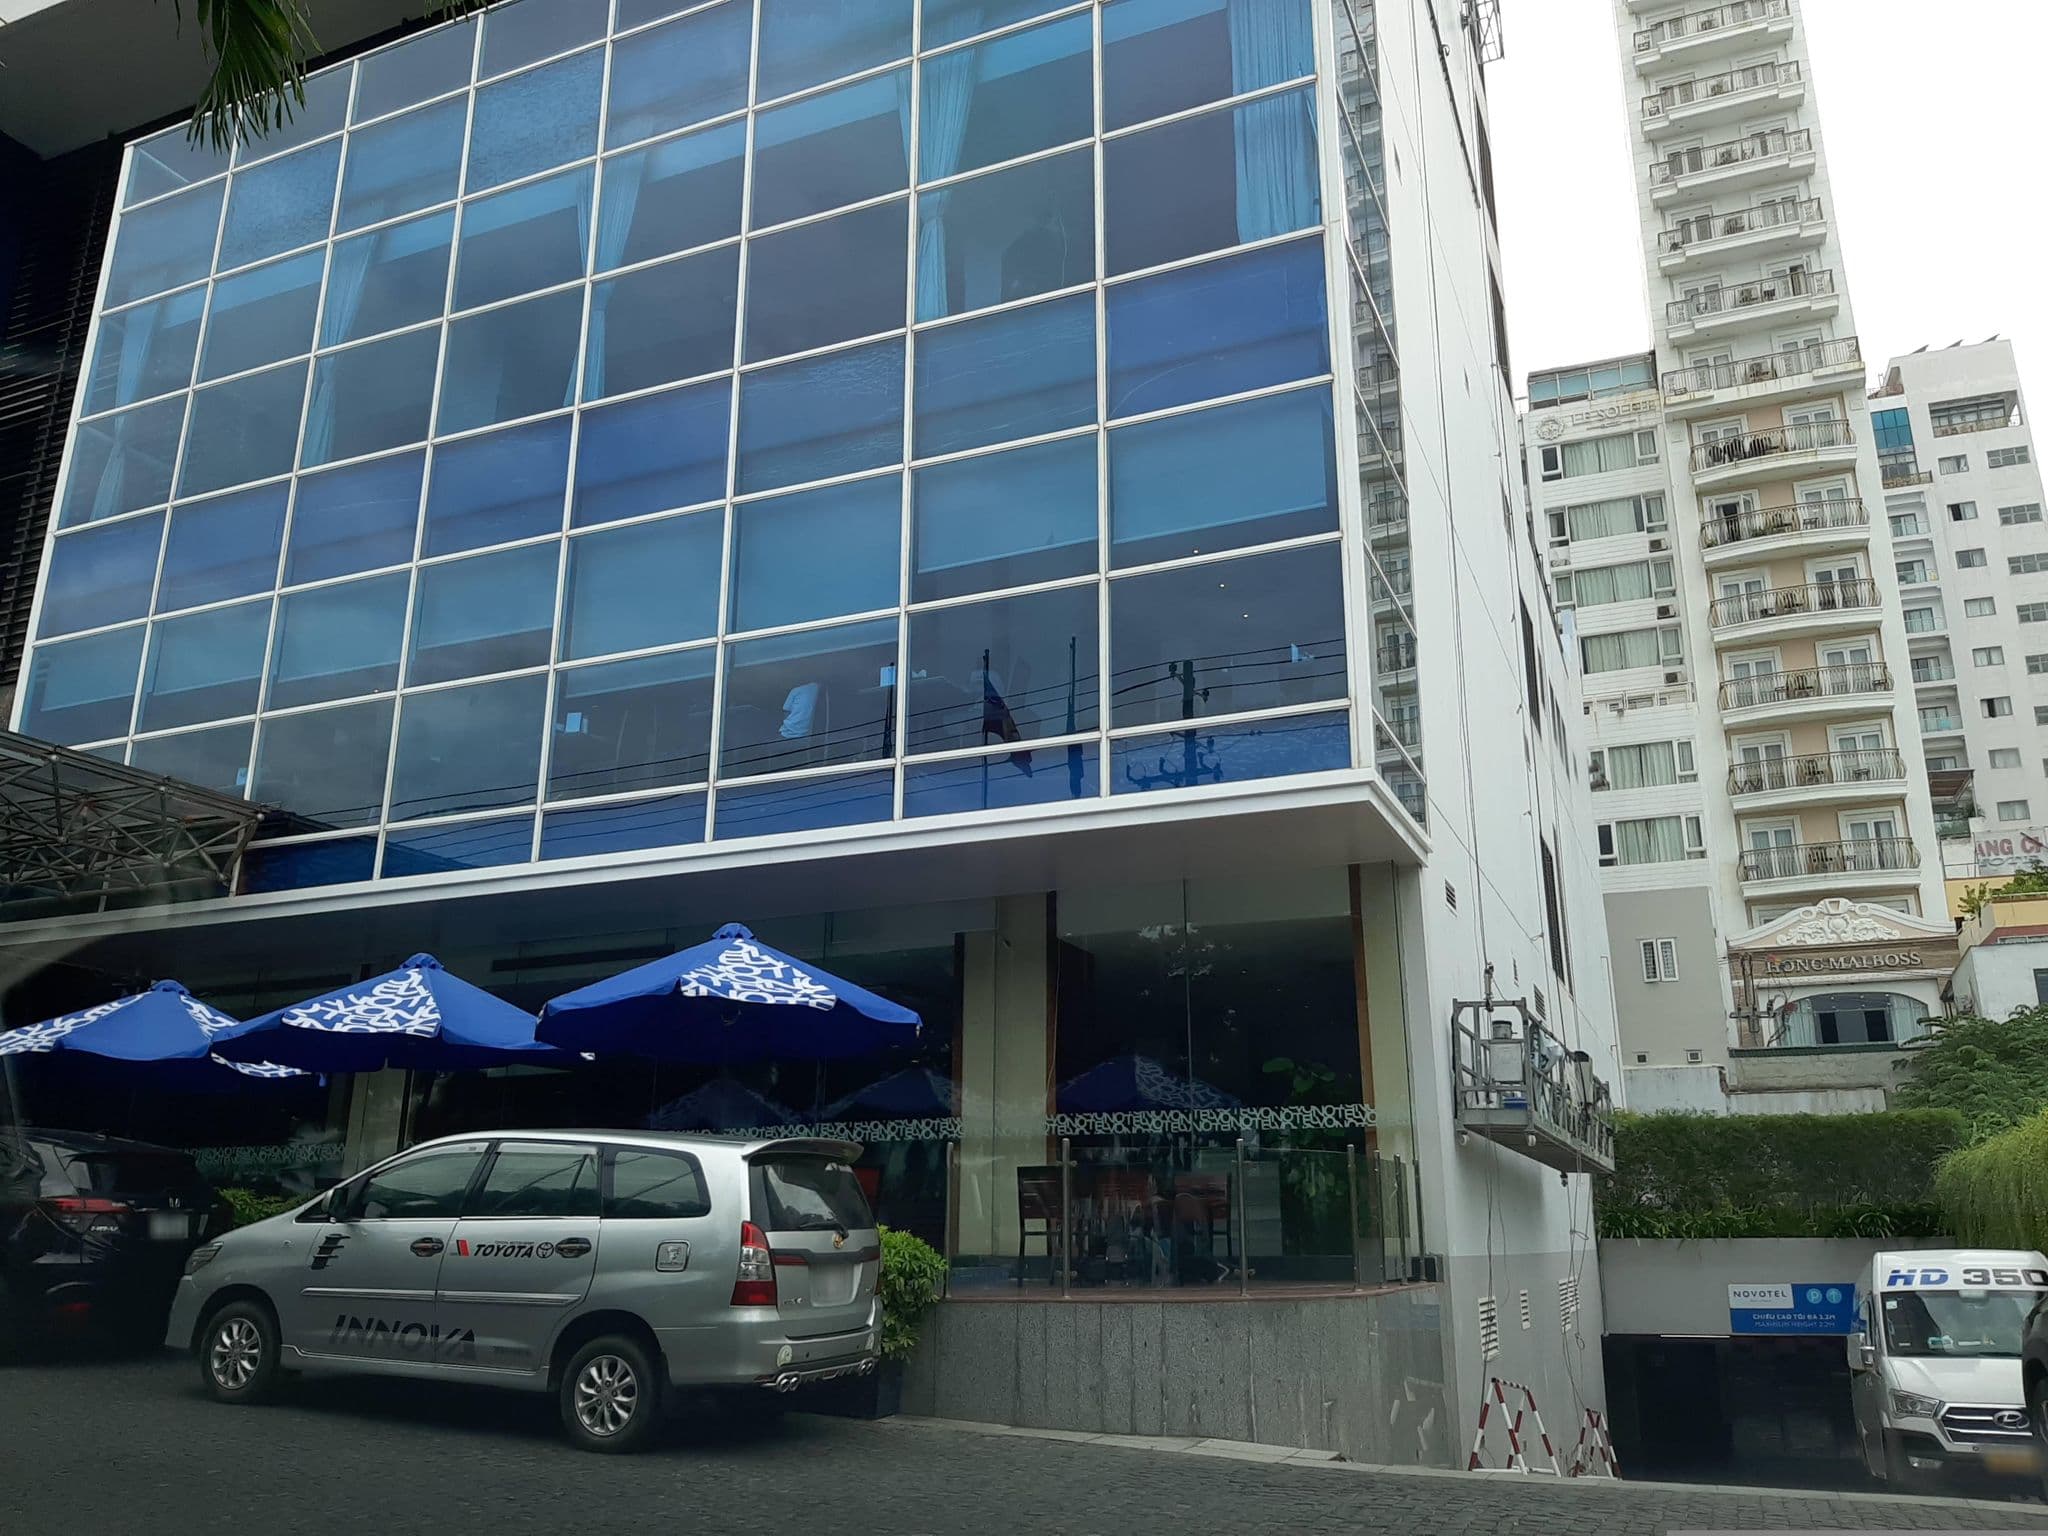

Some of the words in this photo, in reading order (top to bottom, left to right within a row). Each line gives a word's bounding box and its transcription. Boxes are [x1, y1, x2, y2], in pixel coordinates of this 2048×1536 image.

[474, 1244, 534, 1258] TOYOTA
[1887, 1268, 1949, 1287] HD
[1962, 1268, 2048, 1286] 350
[1733, 1290, 1787, 1298] NOVOTEL
[329, 1314, 476, 1360] INNOVA
